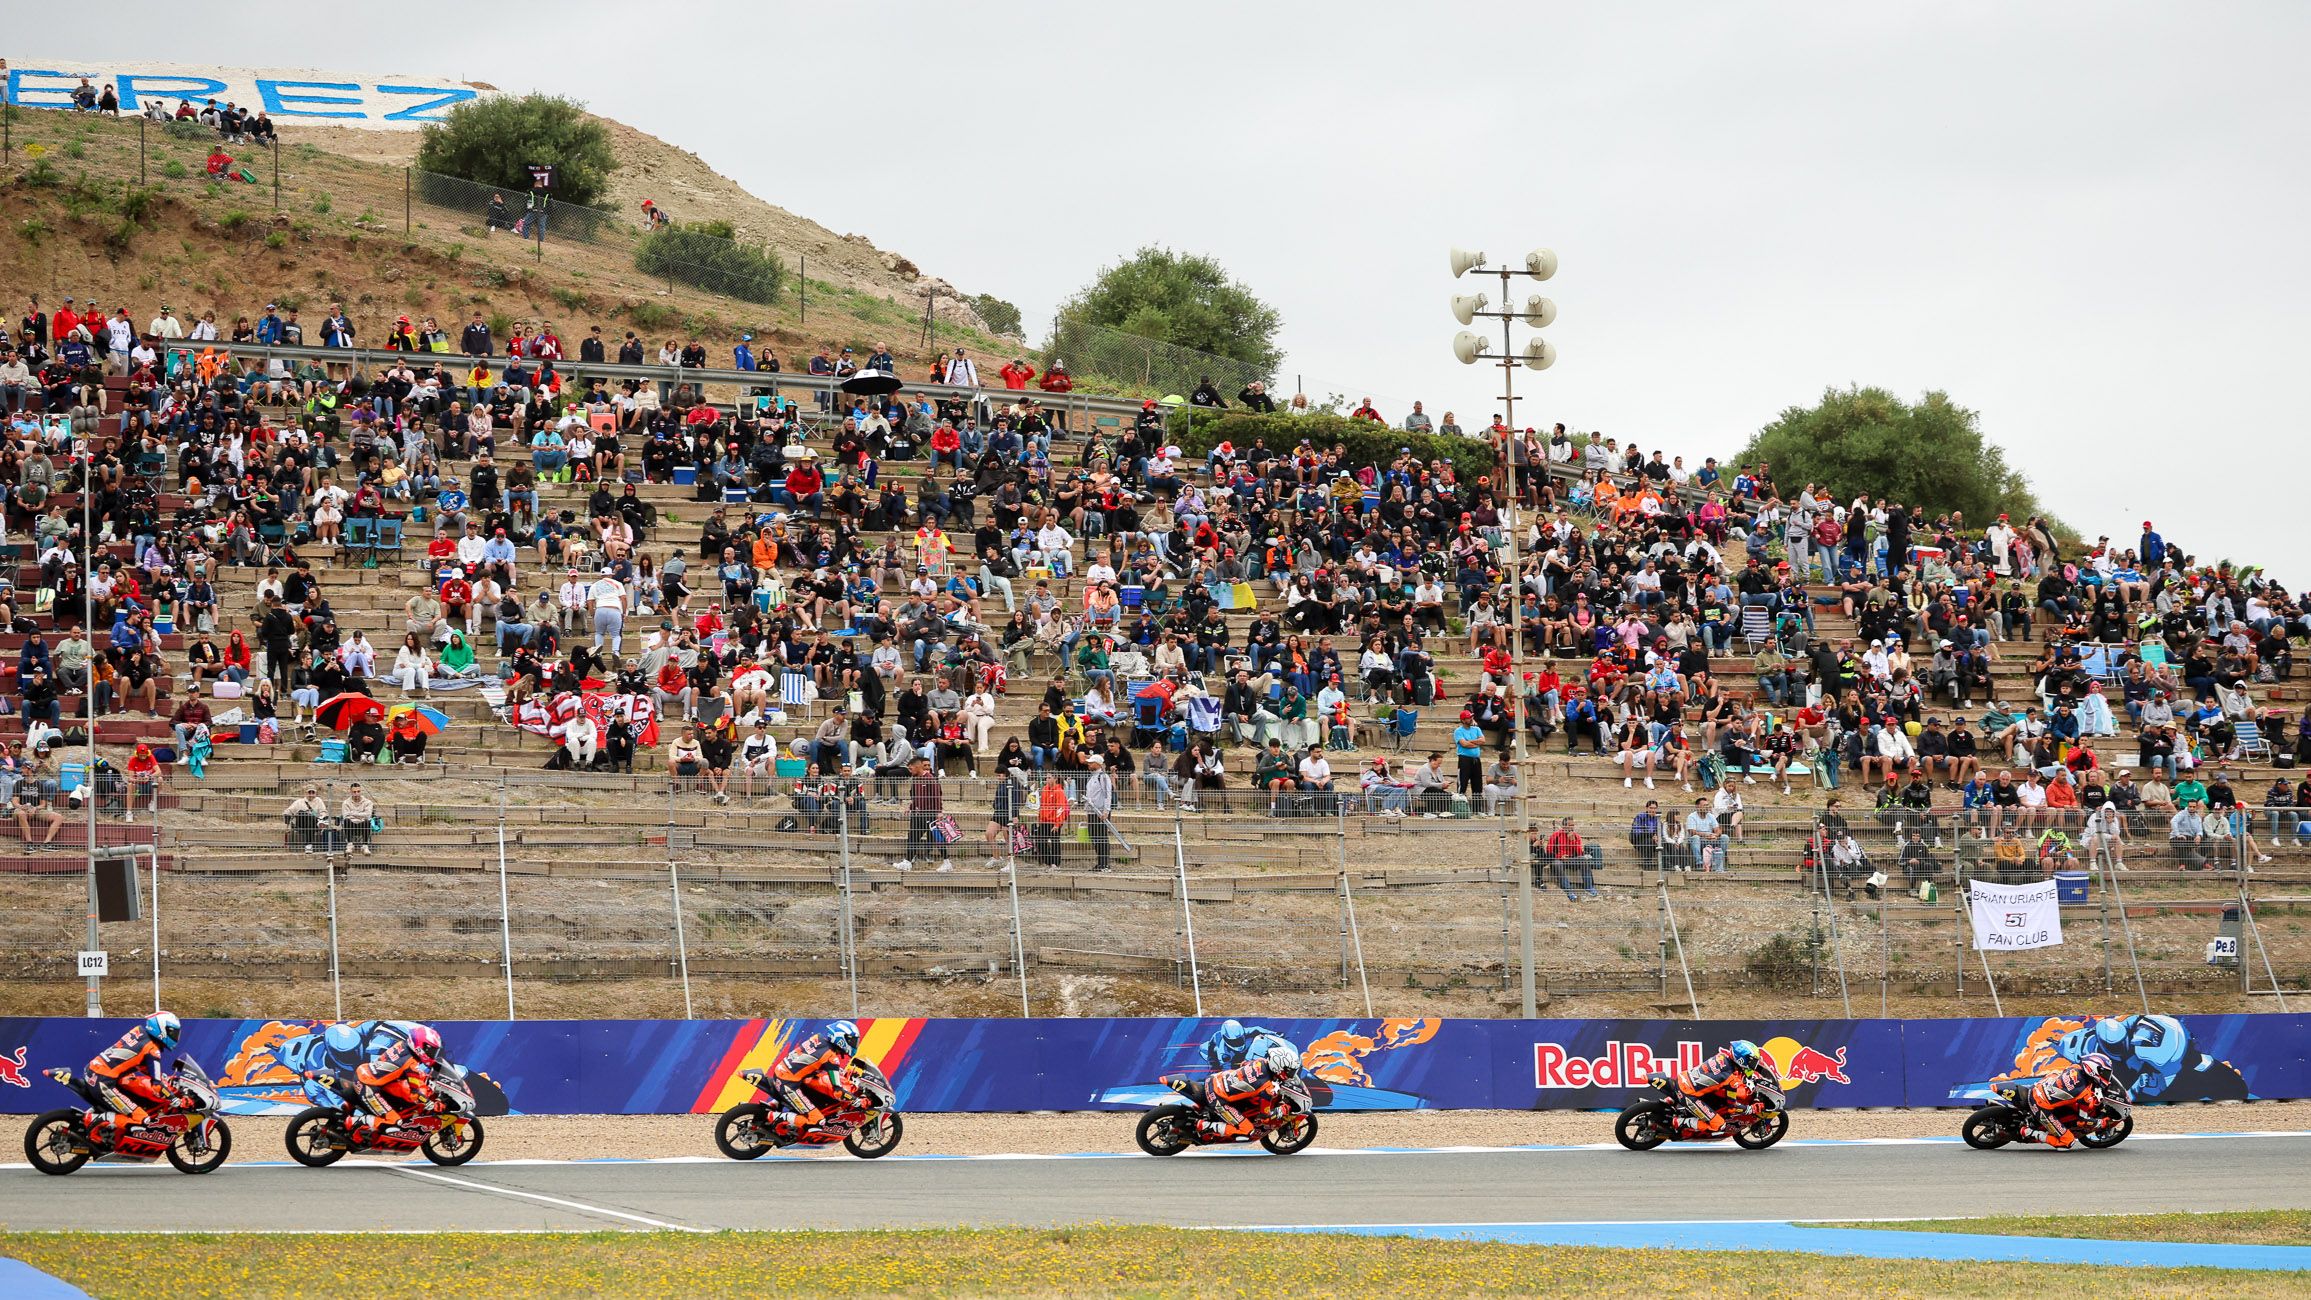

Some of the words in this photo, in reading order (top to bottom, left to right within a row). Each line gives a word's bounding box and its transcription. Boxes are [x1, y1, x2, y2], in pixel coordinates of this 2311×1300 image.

[1972, 890, 2006, 903] BRIAN
[2008, 888, 2056, 904] URIARTE
[2005, 912, 2027, 928] 51
[1987, 933, 2012, 946] FAN
[2015, 930, 2049, 946] CLUB
[2215, 939, 2236, 953] Pe.8
[83, 957, 103, 968] LC12
[1534, 1041, 1622, 1089] Red
[54, 1070, 72, 1086] 24
[317, 1073, 335, 1090] 22
[746, 1072, 763, 1086] 57
[1171, 1079, 1188, 1092] 17
[1651, 1077, 1667, 1090] 27
